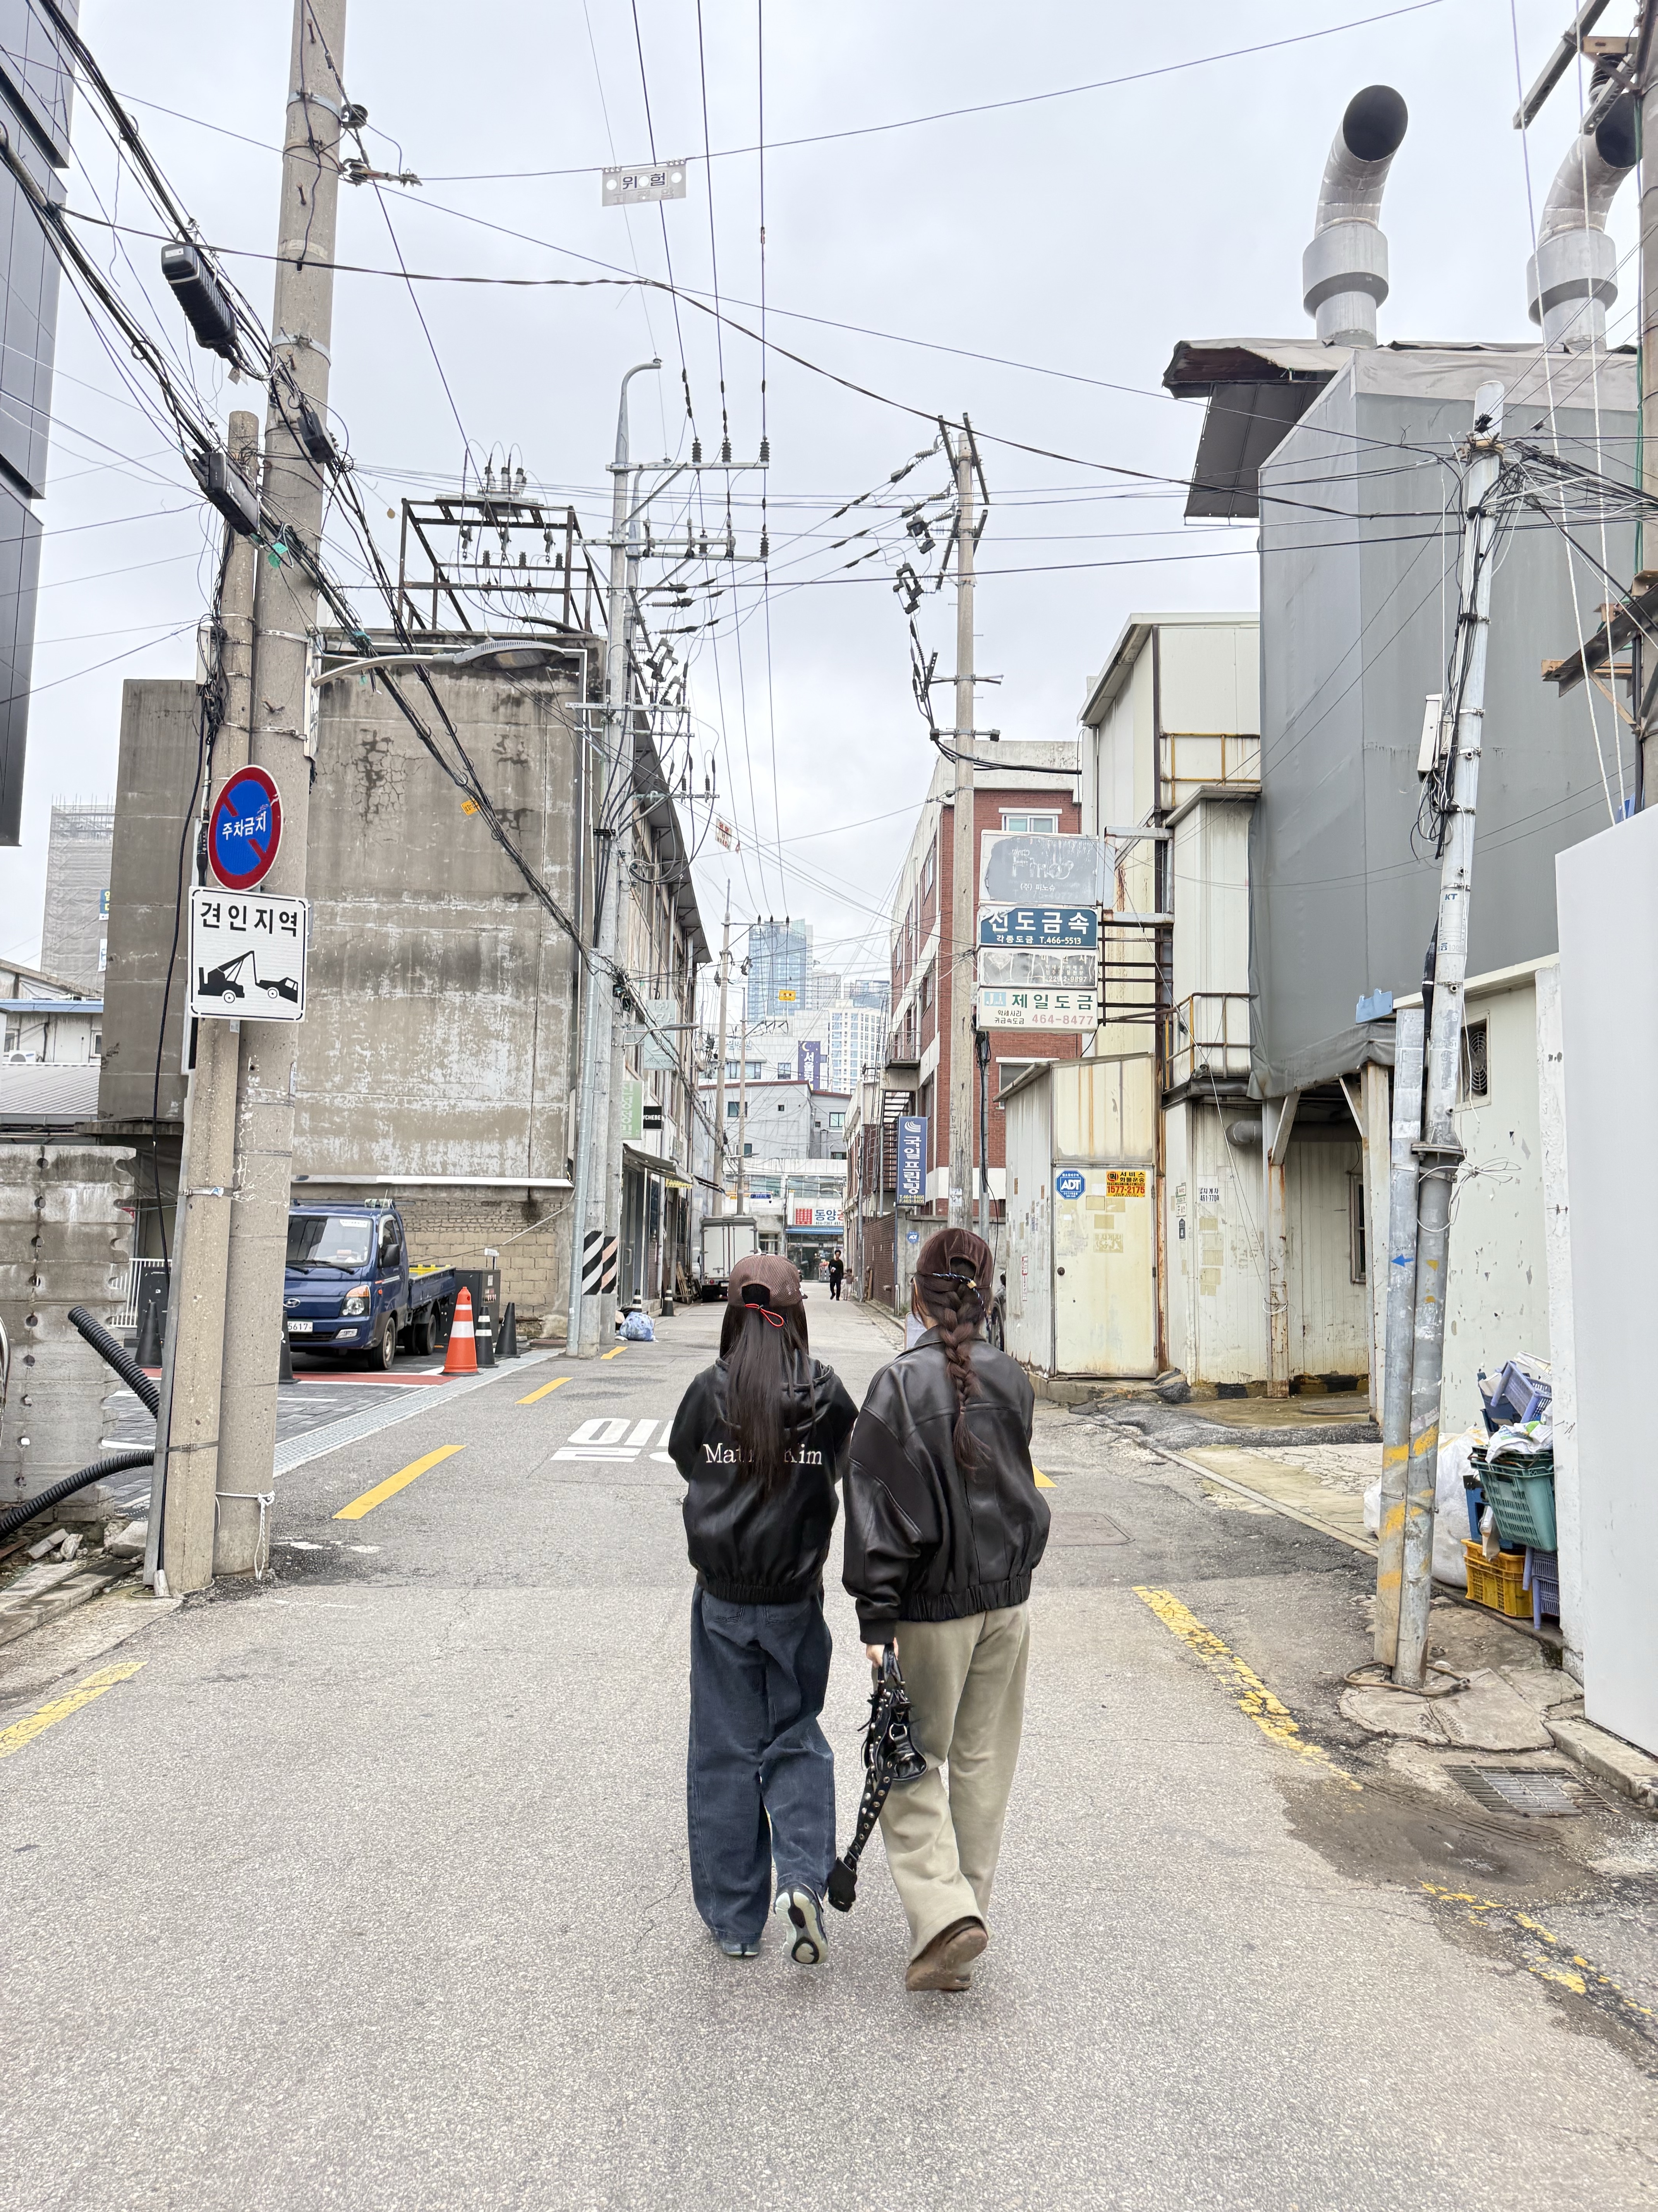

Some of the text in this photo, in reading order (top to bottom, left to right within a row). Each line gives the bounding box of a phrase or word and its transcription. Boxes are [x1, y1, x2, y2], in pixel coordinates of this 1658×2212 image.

[623, 173, 665, 190] 위험
[222, 811, 266, 841] 주차금지
[201, 902, 297, 937] 견인지역
[997, 935, 1081, 945] 각종도금 T.466-5513
[1012, 994, 1093, 1010] 제일도금
[1032, 1014, 1093, 1025] 464-8477
[903, 1136, 922, 1194] 국일프린팅
[1061, 1180, 1081, 1190] ADT
[702, 1443, 754, 1463] Mat
